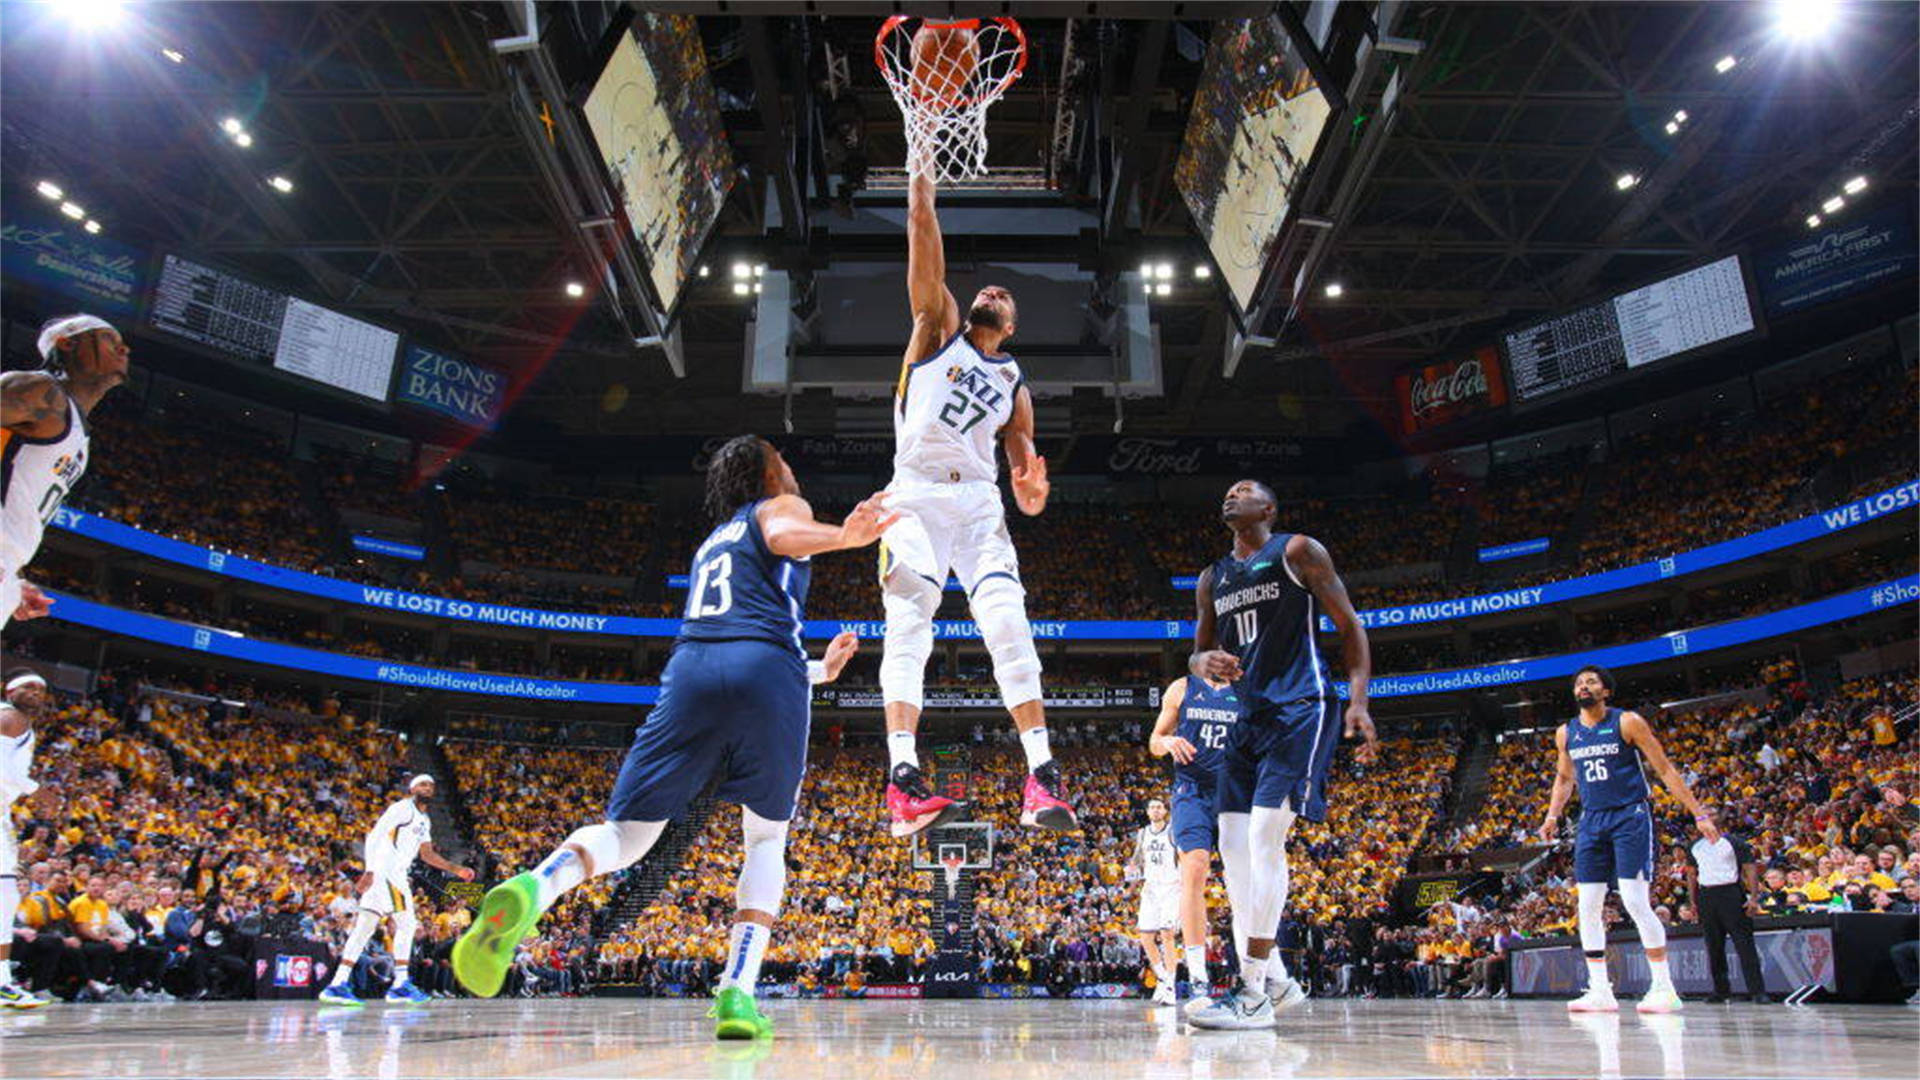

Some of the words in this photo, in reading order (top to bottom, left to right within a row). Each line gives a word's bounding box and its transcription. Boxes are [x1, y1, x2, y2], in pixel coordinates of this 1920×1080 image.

[413, 348, 496, 395] ZIONS
[409, 374, 489, 418] BANK
[939, 390, 987, 435] 27
[1109, 437, 1203, 474] Ford
[1823, 504, 1861, 529] WE
[1865, 482, 1920, 516] LOST
[689, 552, 732, 619] 13
[1214, 581, 1280, 617] MAVERICKS
[363, 588, 393, 606] WE
[399, 594, 443, 613] LOST
[447, 602, 474, 617] SO
[478, 606, 534, 625] MUCH
[538, 614, 607, 631] MONEY
[1379, 610, 1404, 625] SO
[1409, 600, 1466, 620] MUCH
[1471, 588, 1543, 613] MONEY
[944, 623, 982, 636] MUC
[1234, 609, 1258, 646] 10
[377, 665, 577, 698] #ShouldHaveUsedARealtor
[1186, 707, 1238, 724] MAVERICK
[1200, 723, 1227, 749] 42
[1584, 758, 1609, 782] 26
